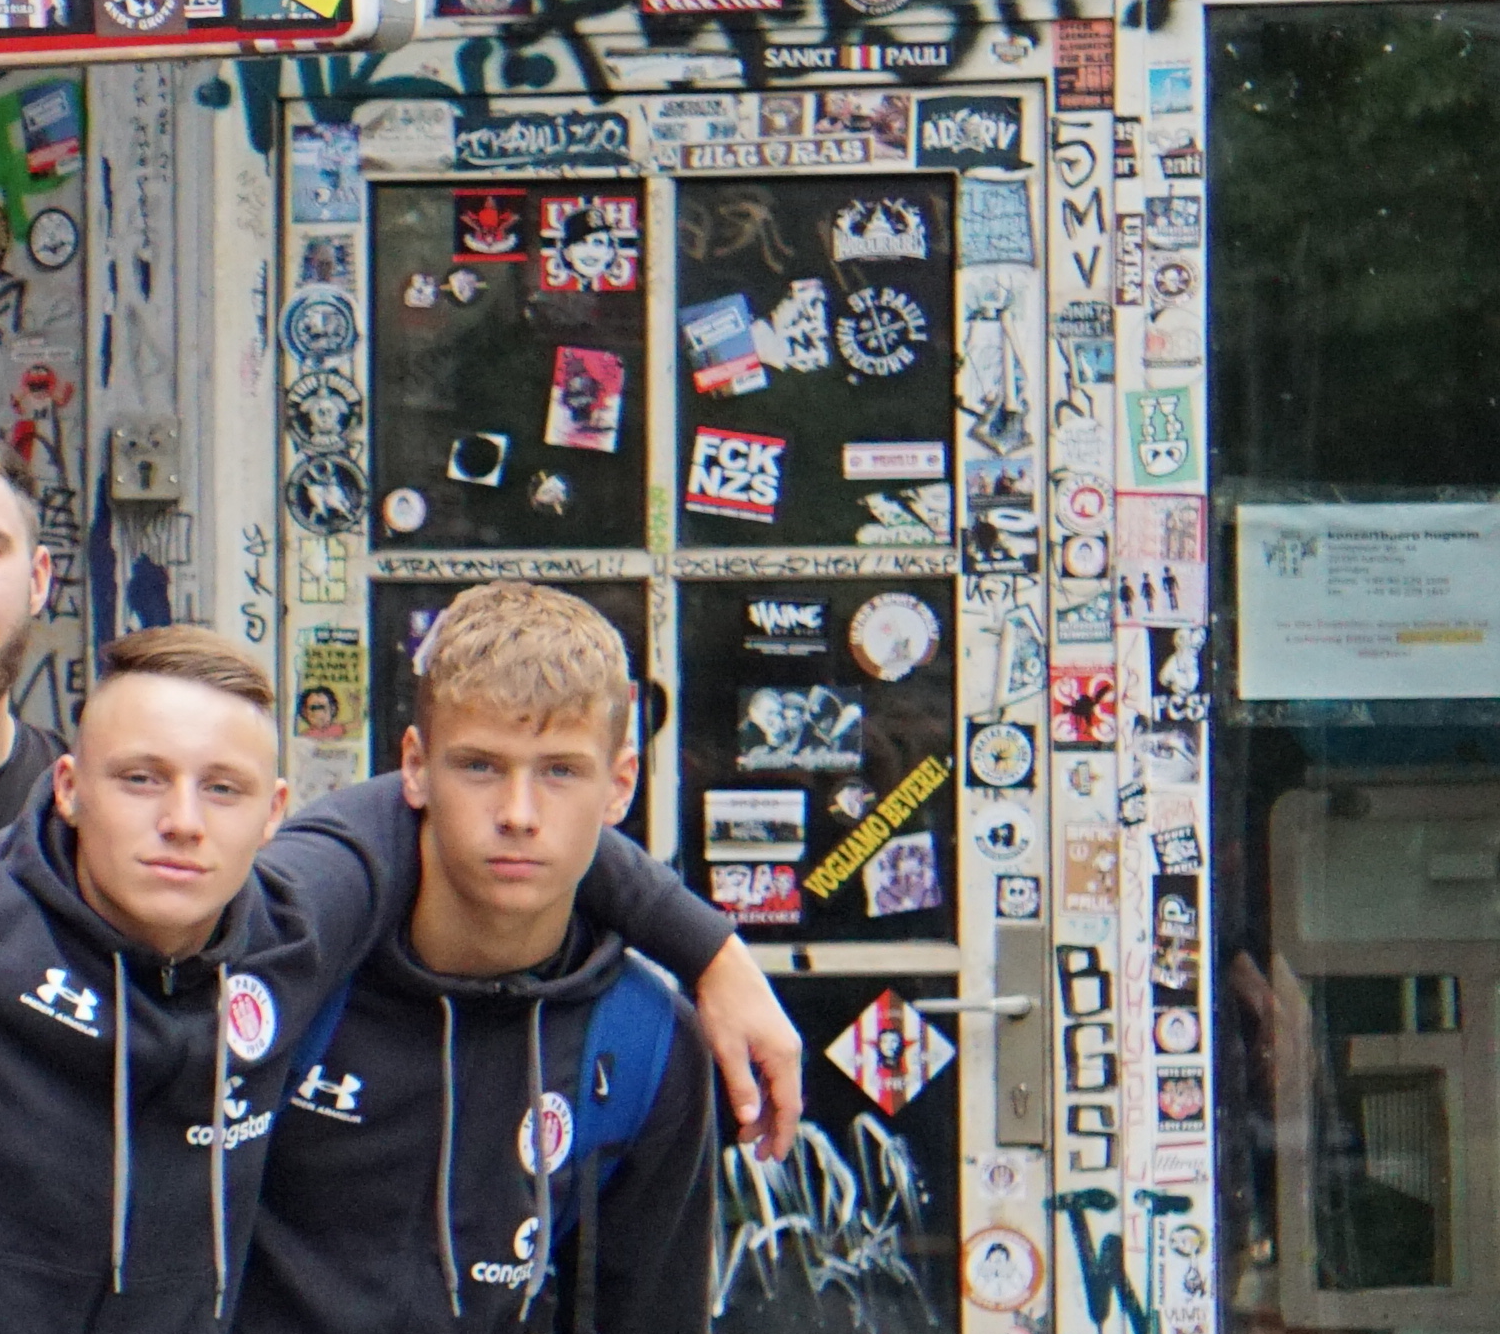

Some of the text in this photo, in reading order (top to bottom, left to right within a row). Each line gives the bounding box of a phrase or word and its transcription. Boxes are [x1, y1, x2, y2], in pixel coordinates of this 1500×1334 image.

[763, 45, 948, 68] SANKT PAULI
[695, 436, 784, 478] FCK
[689, 466, 779, 505] NZS
[803, 755, 953, 899] VOGLIAMO BEVERE!
